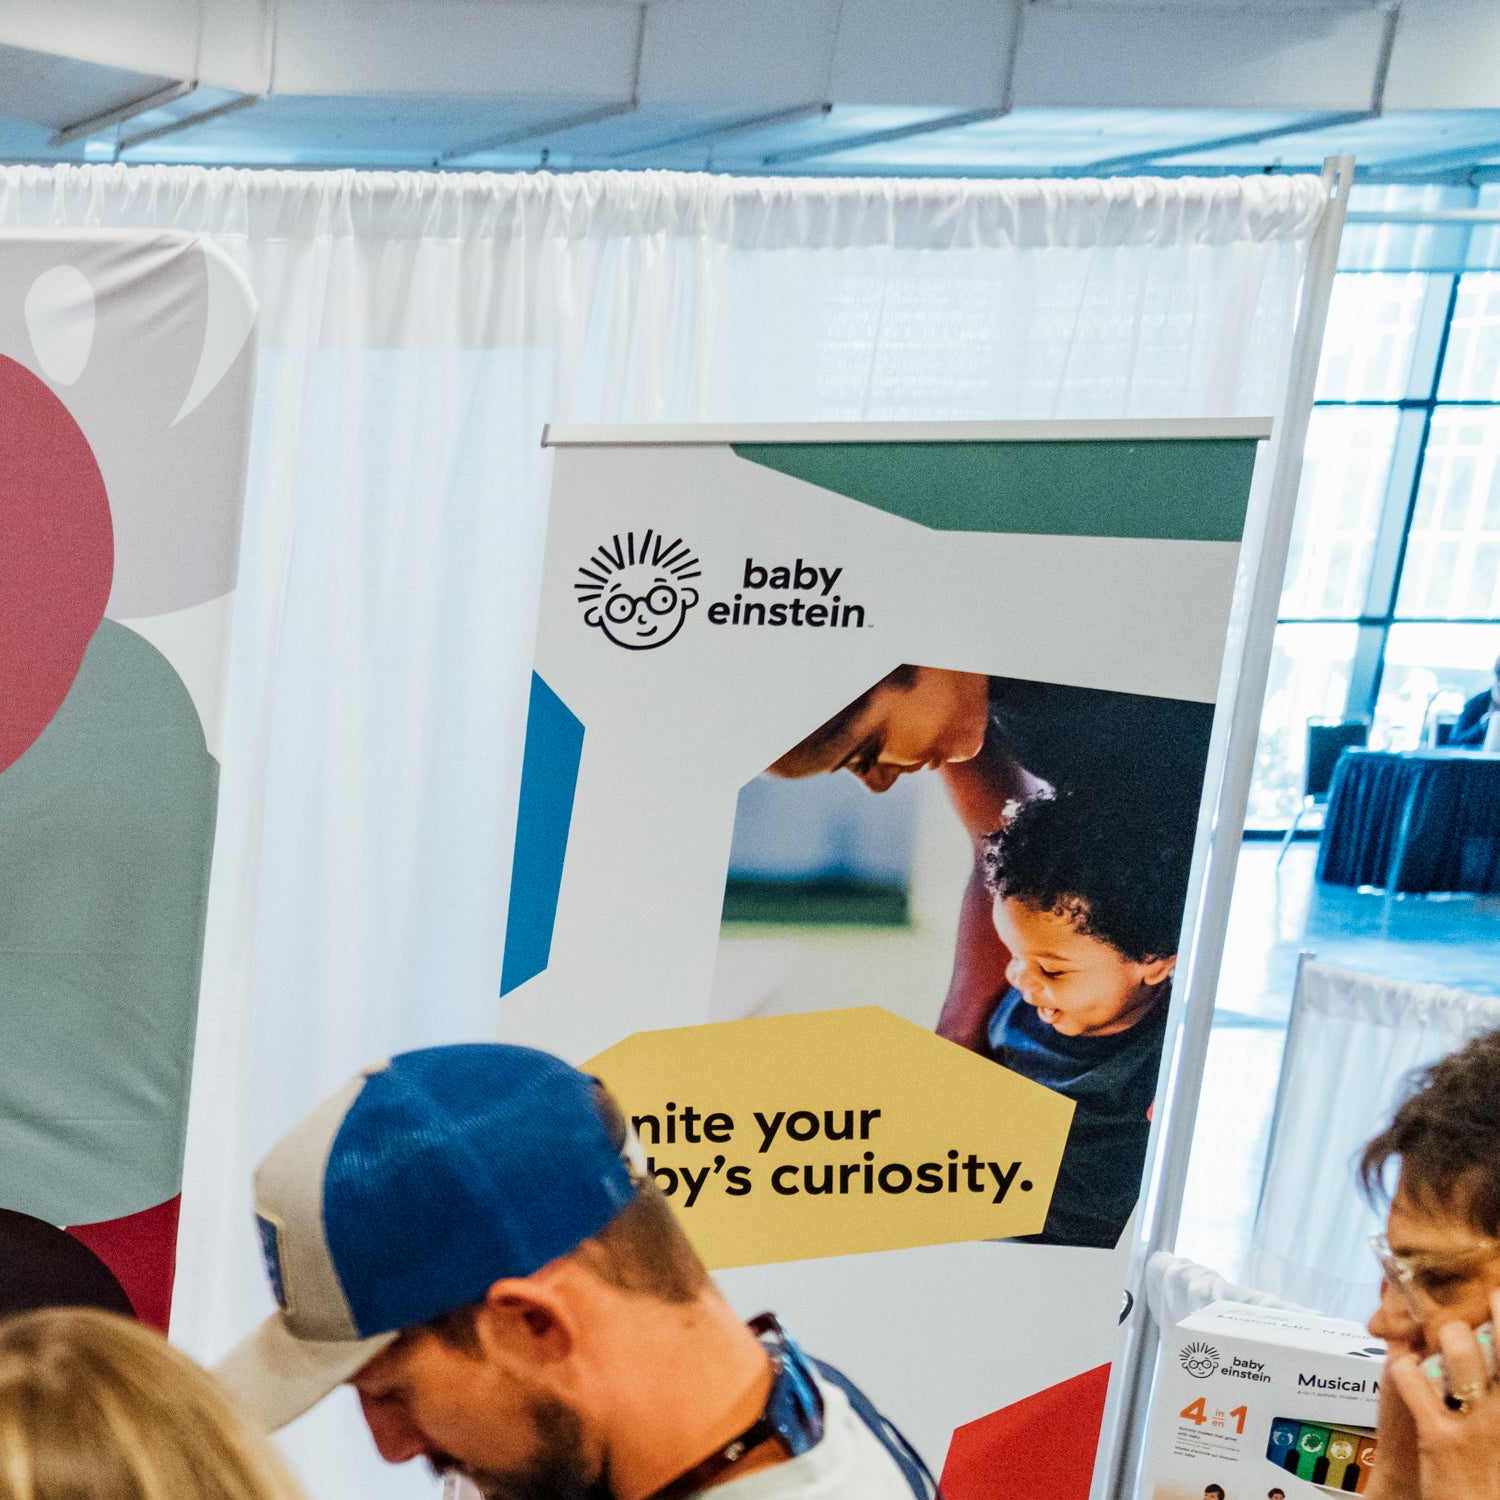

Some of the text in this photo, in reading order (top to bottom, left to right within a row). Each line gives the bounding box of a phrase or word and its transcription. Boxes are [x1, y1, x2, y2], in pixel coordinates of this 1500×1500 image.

[743, 558, 843, 599] baby
[707, 593, 866, 629] einstein
[753, 1107, 882, 1154] your
[771, 1150, 1034, 1205] curiosity.
[1220, 1366, 1272, 1384] einstein
[1232, 1356, 1264, 1372] baby
[1297, 1373, 1366, 1393] Musical
[1180, 1397, 1207, 1426] 4
[1229, 1405, 1248, 1435] 1
